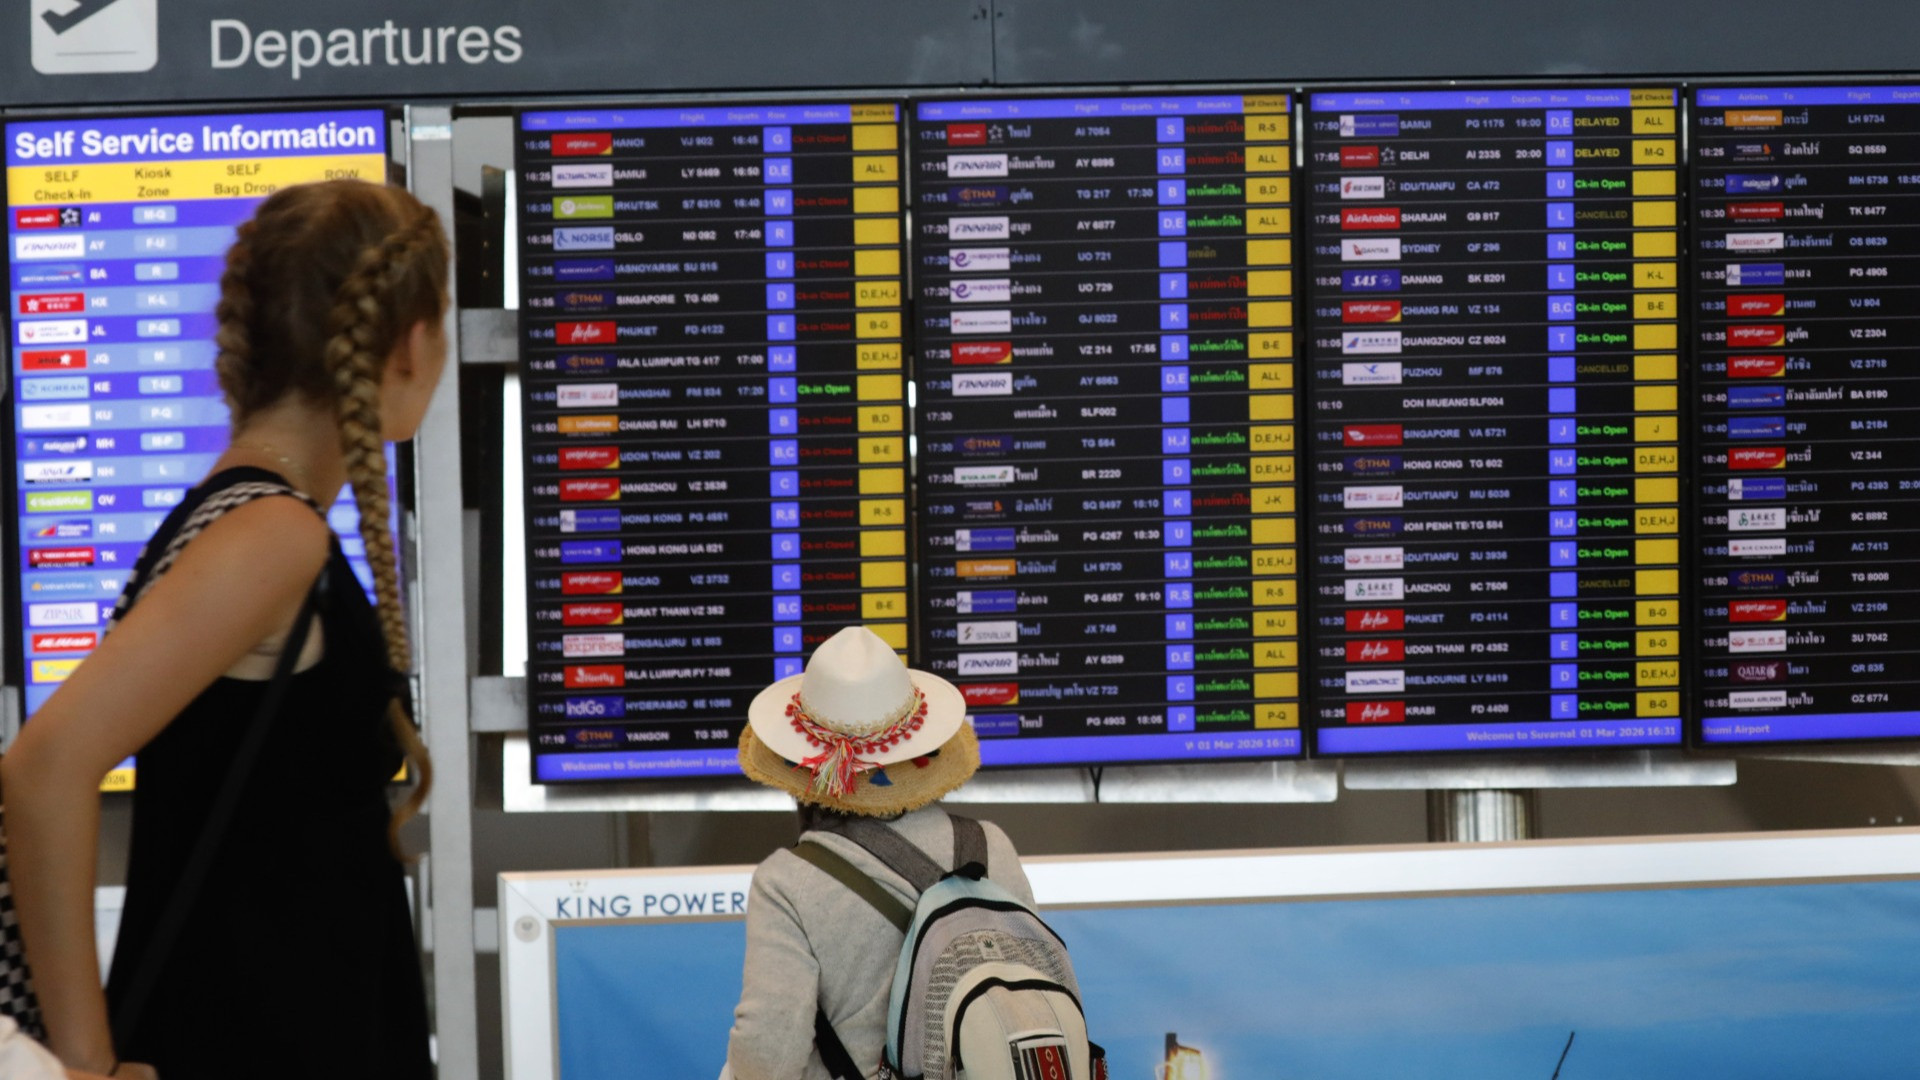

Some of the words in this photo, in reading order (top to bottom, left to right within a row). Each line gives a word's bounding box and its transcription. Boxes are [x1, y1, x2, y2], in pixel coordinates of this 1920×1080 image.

[210, 19, 523, 80] Departures
[1551, 117, 1571, 128] D,E
[1574, 117, 1619, 127] DELAYED
[1644, 116, 1663, 126] ALL
[1258, 123, 1277, 132] R-S
[15, 131, 74, 158] Self
[81, 130, 194, 156] Service
[202, 122, 375, 151] Information
[1400, 150, 1429, 161] DELHI
[1574, 148, 1620, 158] DELAYED
[1644, 147, 1665, 157] M-Q
[1258, 154, 1277, 164] ALL
[134, 167, 173, 179] Kiosk
[226, 163, 262, 177] SELF
[865, 164, 886, 174] ALL
[43, 170, 80, 183] SELF
[213, 182, 241, 196] Bag
[1574, 179, 1599, 189] Ck-in
[1601, 179, 1626, 191] Open
[137, 185, 170, 198] Zone
[971, 189, 996, 199] THAI
[1259, 185, 1277, 196] B,D
[1346, 213, 1396, 224] AirArabia
[1401, 212, 1447, 222] SHARJAH
[571, 232, 611, 244] NORSE
[1731, 237, 1766, 246] Austrian
[1401, 243, 1441, 253] SYDNEY
[1401, 274, 1443, 284] DANANG
[1574, 271, 1599, 282] Ck-in
[1601, 271, 1627, 284] Open
[1647, 271, 1664, 280] K-L
[1647, 301, 1665, 311] B-E
[1402, 336, 1464, 346] GUANGZHOU
[1558, 333, 1566, 343] T
[1262, 340, 1280, 350] B-E
[1261, 371, 1281, 381] ALL
[823, 384, 851, 396] Open
[1403, 429, 1461, 439] SINGAPORE
[1653, 425, 1660, 434] J
[1366, 459, 1391, 468] THAI
[1639, 455, 1675, 466] D,E,H,J
[1264, 495, 1282, 505] J-K
[1750, 574, 1774, 582] THAI
[1266, 588, 1284, 597] R-S
[1648, 608, 1667, 618] B-G
[1266, 618, 1286, 627] M-U
[1266, 649, 1285, 659] ALL
[963, 657, 1012, 669] FINNAIR
[1640, 669, 1676, 680] D,E,H,J
[1737, 666, 1766, 676] QATAR
[1578, 701, 1602, 711] Ck-in
[1604, 700, 1629, 712] Open
[1649, 699, 1667, 710] B-G
[1268, 711, 1287, 721] P-Q
[1467, 731, 1513, 741] Welcome
[1516, 731, 1529, 741] to
[1579, 727, 1594, 737] 01
[1595, 727, 1617, 737] Mar
[1619, 728, 1646, 737] 2026
[1647, 726, 1676, 736] 16:31
[1734, 724, 1771, 734] Airport
[1197, 739, 1210, 749] 01
[1212, 738, 1234, 749] Mar
[1237, 739, 1264, 749] 2026
[1266, 738, 1296, 748] 16:31
[561, 761, 614, 772] Welcome
[705, 757, 740, 771] Airpo
[556, 895, 632, 919] KING
[644, 892, 746, 916] POWER
